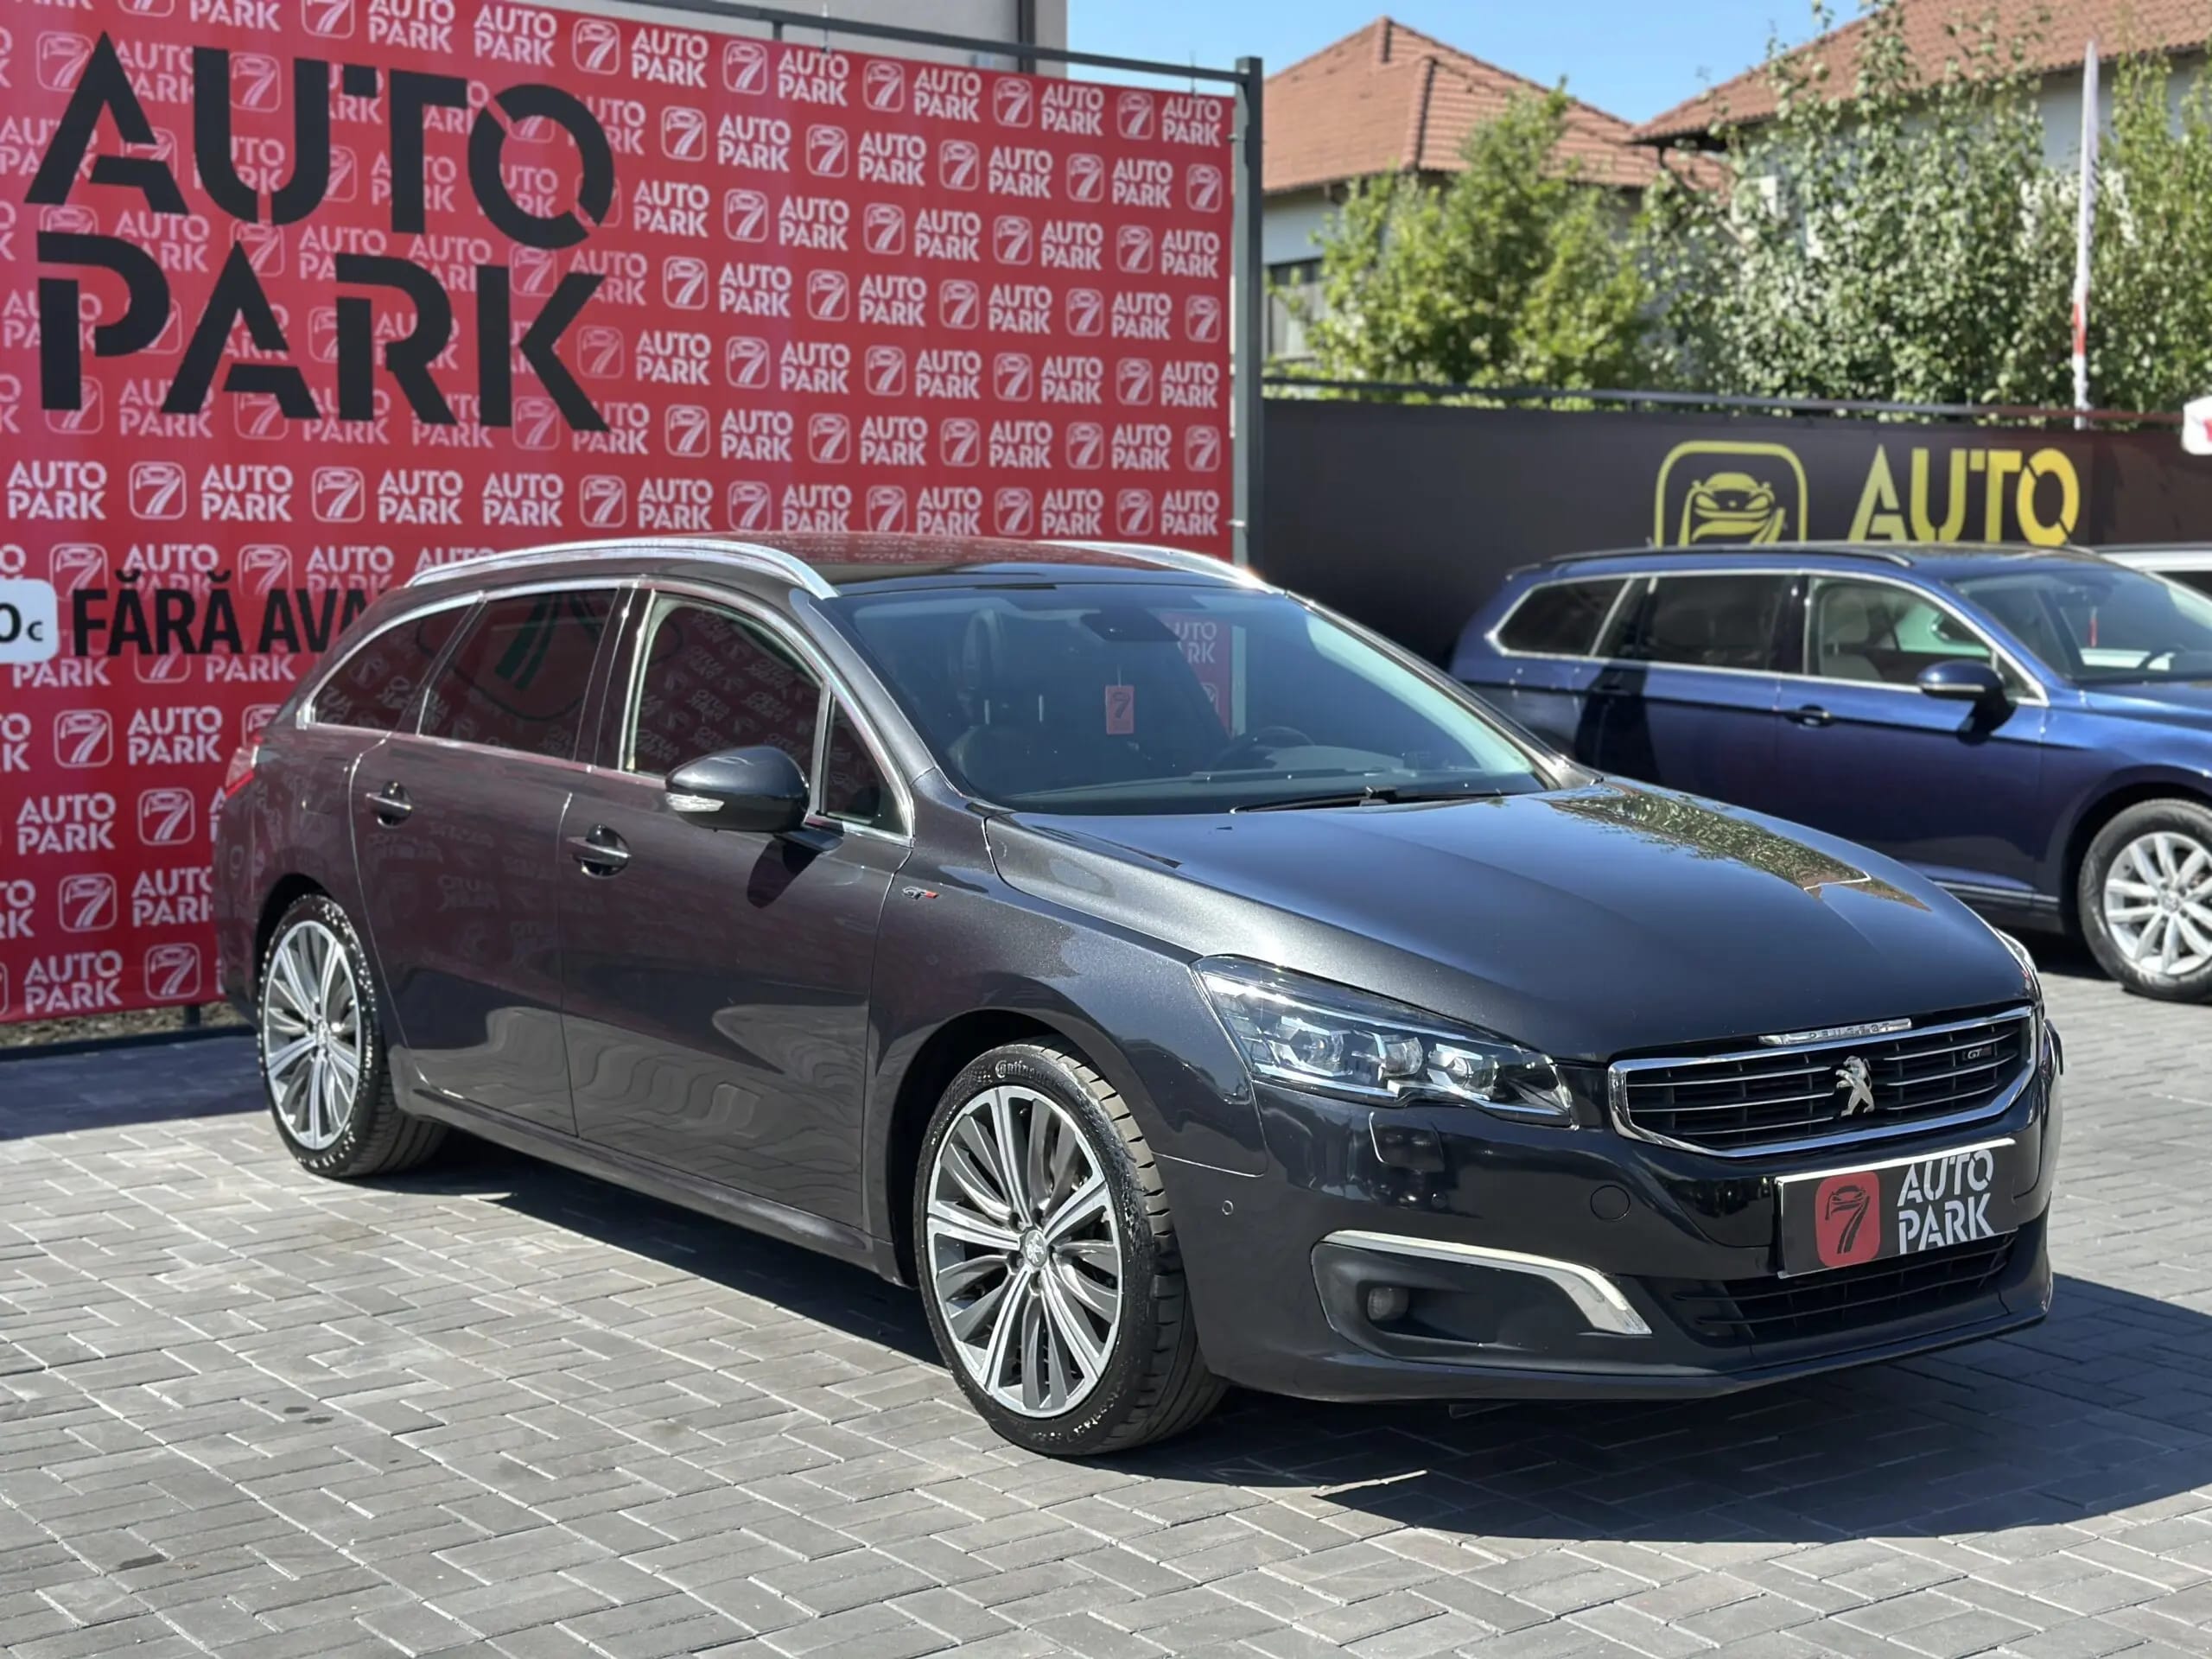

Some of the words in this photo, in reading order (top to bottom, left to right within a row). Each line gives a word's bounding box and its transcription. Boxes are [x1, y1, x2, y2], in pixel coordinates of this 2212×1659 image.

[190, 0, 281, 33] PARK
[368, 0, 455, 24] AUTO
[474, 4, 558, 39] AUTO
[369, 16, 453, 54] PARK
[475, 29, 555, 67] PARK
[632, 28, 709, 60] AUTO
[632, 52, 707, 88] PARK
[778, 49, 849, 79] AUTO
[779, 73, 847, 107] PARK
[914, 68, 982, 97] AUTO
[573, 94, 646, 128] UTO
[914, 91, 980, 123] PARK
[1042, 84, 1104, 111] AUTO
[1162, 97, 1221, 122] AUTO
[717, 114, 791, 145] AUTO
[1042, 107, 1103, 137] PARK
[1163, 119, 1220, 147] PARK
[25, 30, 615, 251] AUTO
[859, 131, 926, 161] AUTO
[718, 139, 790, 173] PARK
[988, 147, 1052, 175] AUTO
[499, 162, 558, 195] UTO
[859, 156, 925, 187] PARK
[988, 168, 1051, 199] PARK
[1113, 159, 1173, 185] AUTO
[634, 180, 709, 211] AUTO
[1113, 181, 1171, 207] PARK
[634, 206, 709, 238] PARK
[779, 195, 849, 225] AUTO
[914, 209, 982, 237] AUTO
[114, 209, 210, 243] AUTO
[779, 219, 849, 251] PARK
[1041, 221, 1103, 246] AUTO
[299, 224, 387, 257] AUTO
[408, 232, 493, 266] AUTO
[915, 232, 980, 261] PARK
[1161, 230, 1219, 254] AUTO
[569, 248, 647, 280] AUTO
[1042, 244, 1101, 270] PARK
[1161, 251, 1217, 278] PARK
[719, 263, 791, 290] AUTO
[859, 275, 926, 301] AUTO
[719, 287, 790, 318] PARK
[988, 285, 1052, 309] AUTO
[1112, 292, 1172, 317] AUTO
[859, 297, 925, 327] PARK
[988, 308, 1051, 334] PARK
[36, 231, 613, 433] PARK
[1112, 313, 1170, 340] PARK
[636, 330, 711, 358] AUTO
[780, 340, 850, 368] AUTO
[636, 356, 710, 385] PARK
[916, 349, 982, 375] AUTO
[1041, 356, 1103, 380] AUTO
[1161, 361, 1218, 385] AUTO
[781, 365, 849, 394] PARK
[916, 372, 980, 399] PARK
[1042, 378, 1101, 404] PARK
[1161, 384, 1217, 407] PARK
[721, 410, 793, 435] AUTO
[861, 416, 928, 441] AUTO
[989, 422, 1052, 445] AUTO
[1112, 424, 1172, 448] AUTO
[721, 434, 791, 461] PARK
[861, 439, 926, 465] PARK
[990, 442, 1051, 468] PARK
[1112, 446, 1170, 470] PARK
[7, 461, 107, 489] AUTO
[200, 465, 293, 493] AUTO
[378, 469, 463, 496] AUTO
[482, 473, 563, 499] AUTO
[9, 490, 106, 520] PARK
[638, 479, 713, 505] AUTO
[783, 484, 852, 509] AUTO
[918, 487, 982, 511] AUTO
[1042, 489, 1103, 512] AUTO
[1161, 491, 1218, 512] AUTO
[1847, 444, 2080, 547] AUTO
[202, 493, 292, 522] PARK
[378, 496, 461, 524] PARK
[484, 499, 562, 526] PARK
[639, 503, 710, 529] PARK
[782, 508, 849, 534] PARK
[917, 512, 981, 536] PARK
[1042, 512, 1101, 534] PARK
[1161, 512, 1217, 534] PARK
[124, 543, 219, 573] AUTO
[307, 545, 394, 574] AUTO
[73, 569, 244, 657] FĂRĂ
[1175, 620, 1217, 641] UTO
[13, 658, 111, 688] PARK
[205, 653, 296, 683] PARK
[128, 705, 223, 736] AUTO
[129, 734, 221, 766] PARK
[16, 792, 116, 825] AUTO
[17, 821, 115, 855] PARK
[24, 950, 123, 985] AUTO
[26, 978, 122, 1014] PARK
[1897, 1149, 1994, 1207] AUTO
[1899, 1192, 1995, 1255] PARK
